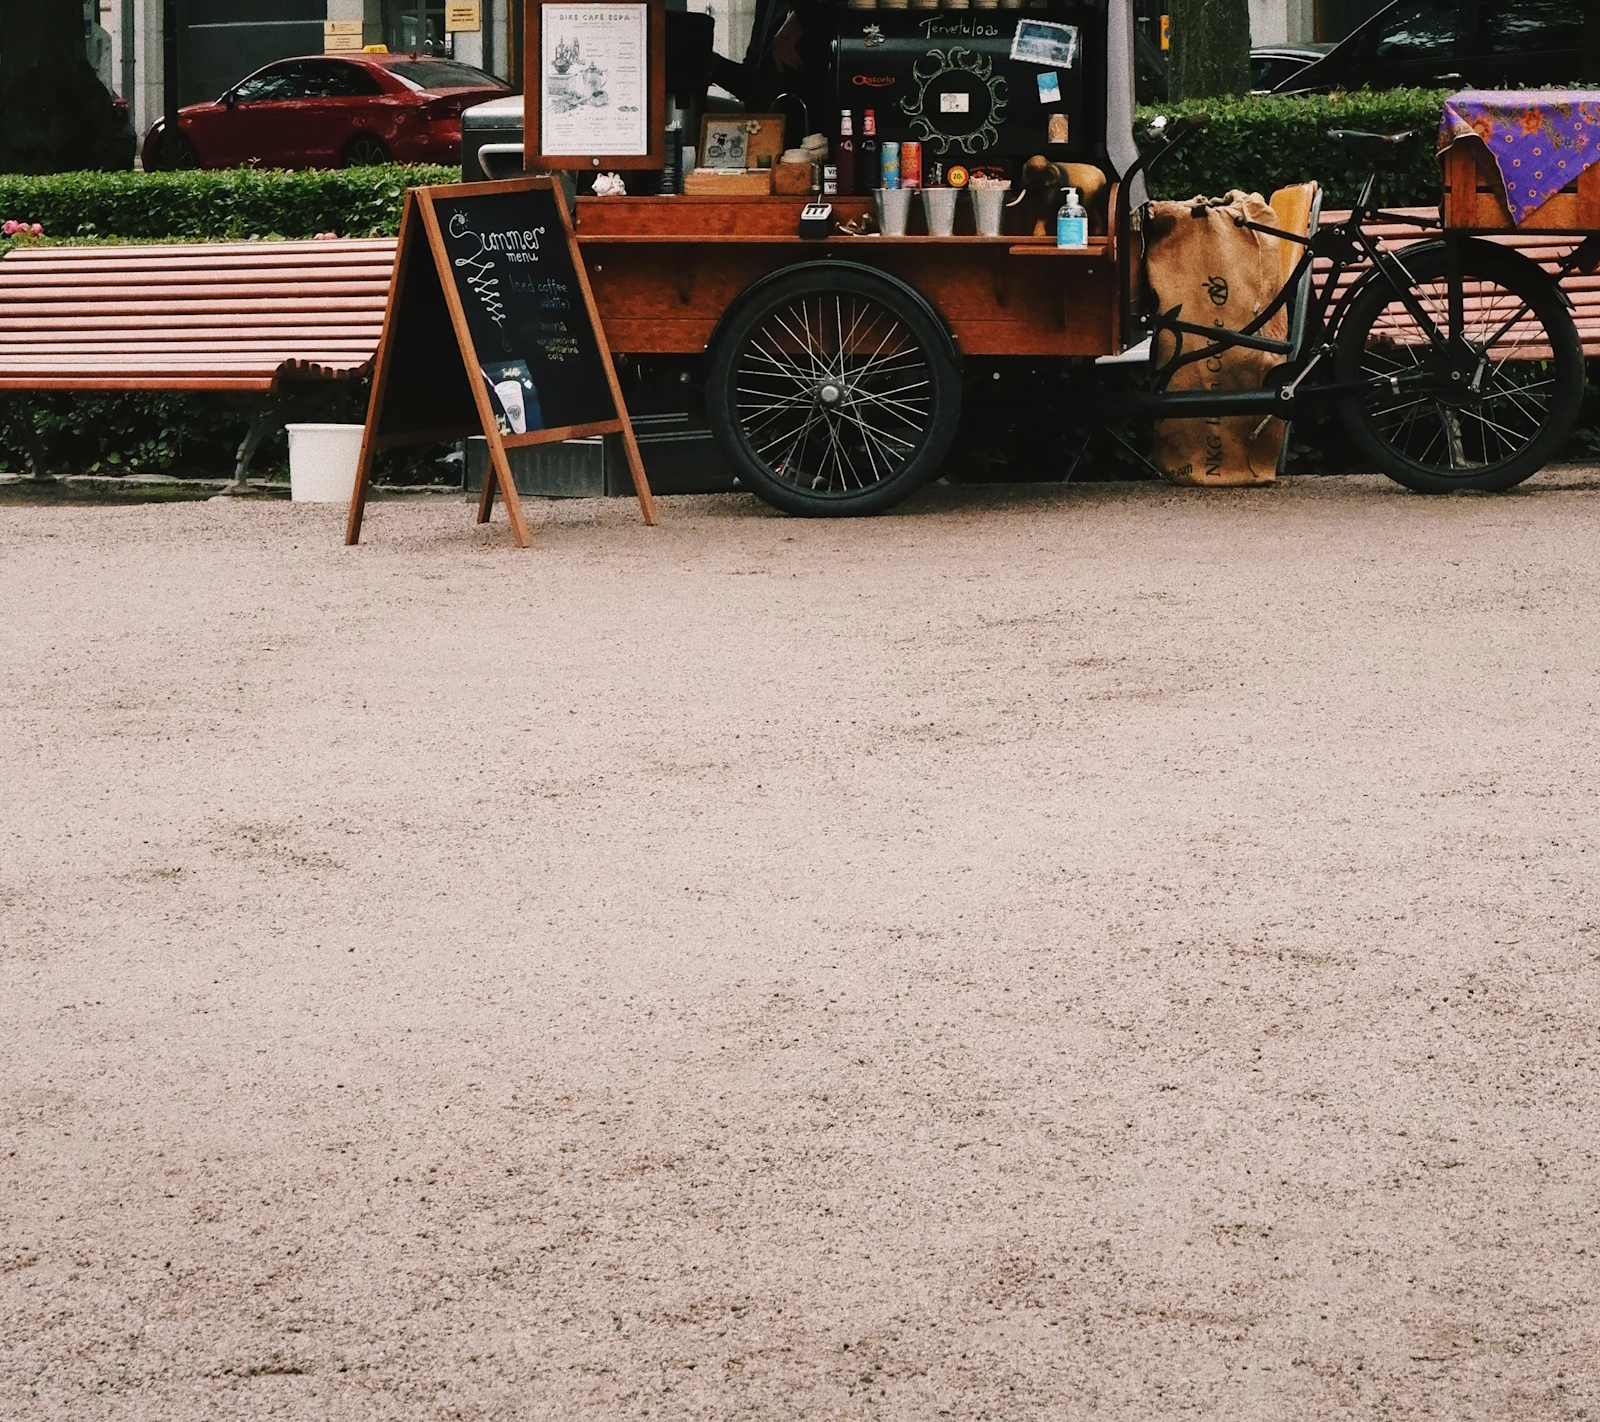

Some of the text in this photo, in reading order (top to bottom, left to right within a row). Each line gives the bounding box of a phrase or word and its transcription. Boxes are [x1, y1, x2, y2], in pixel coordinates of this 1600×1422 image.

[918, 14, 998, 39] Tervetuloa
[448, 213, 545, 256] Summer
[506, 252, 538, 262] menu
[538, 278, 568, 296] coffee
[547, 352, 564, 362] cola
[1205, 436, 1223, 476] NKG
